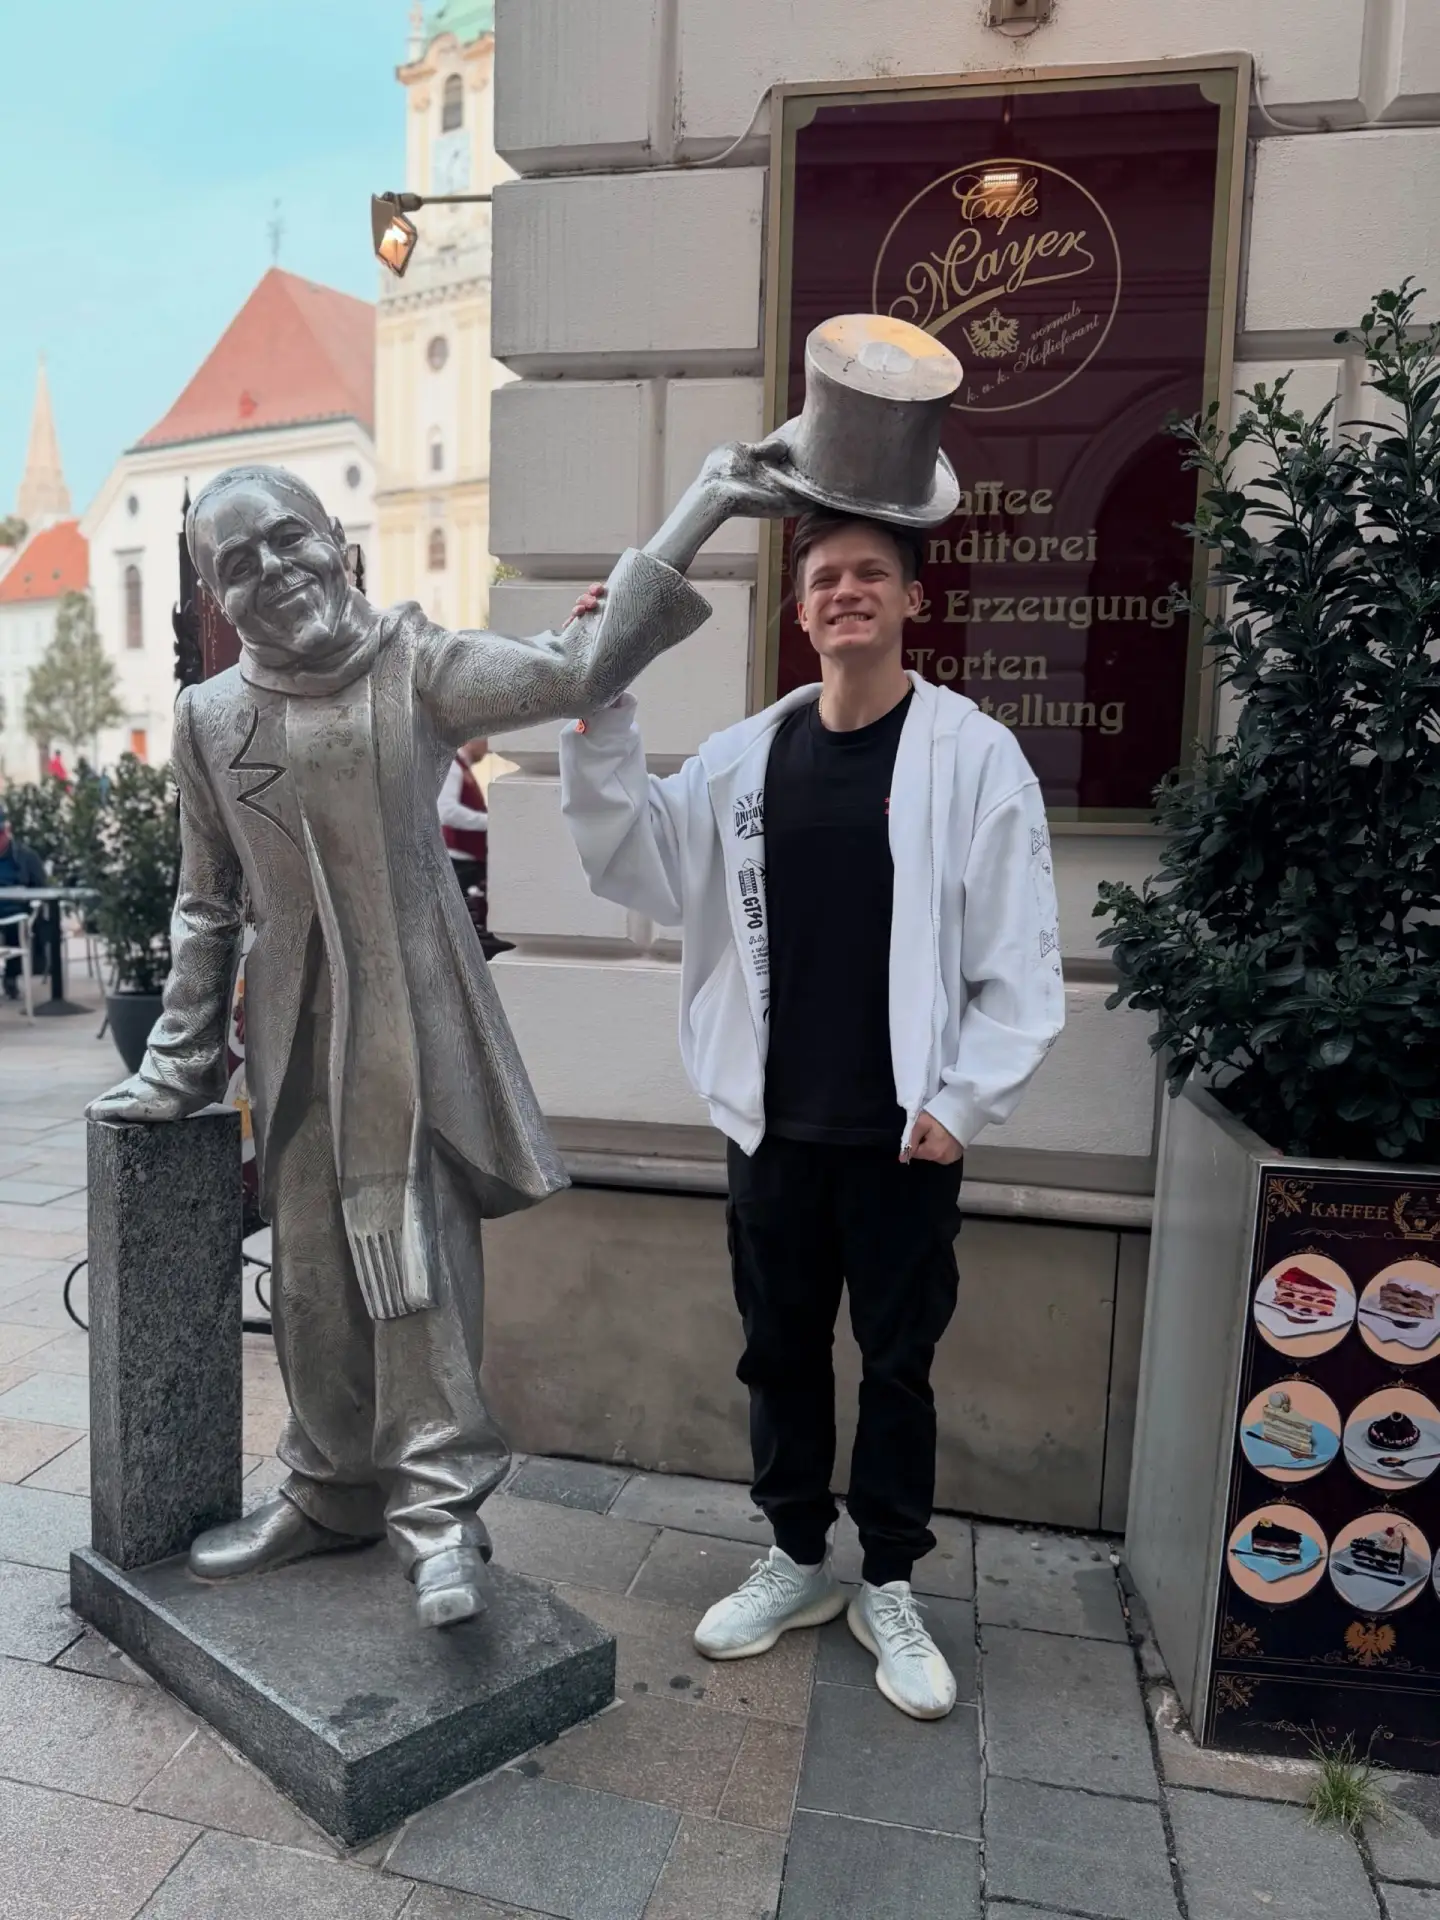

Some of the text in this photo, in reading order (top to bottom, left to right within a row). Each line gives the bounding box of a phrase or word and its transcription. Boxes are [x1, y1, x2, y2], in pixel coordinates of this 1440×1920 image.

[889, 227, 1095, 330] Mayer
[1031, 300, 1081, 341] vormals
[1013, 313, 1100, 373] Hoflieferant
[951, 481, 1053, 516] affee
[927, 530, 1098, 564] nditorei
[944, 590, 1176, 629] Erzeugung
[907, 648, 1048, 682] Torten
[979, 693, 1125, 735] tellung
[735, 804, 765, 828] ONIZUK
[1310, 1201, 1389, 1221] KAFFEE
